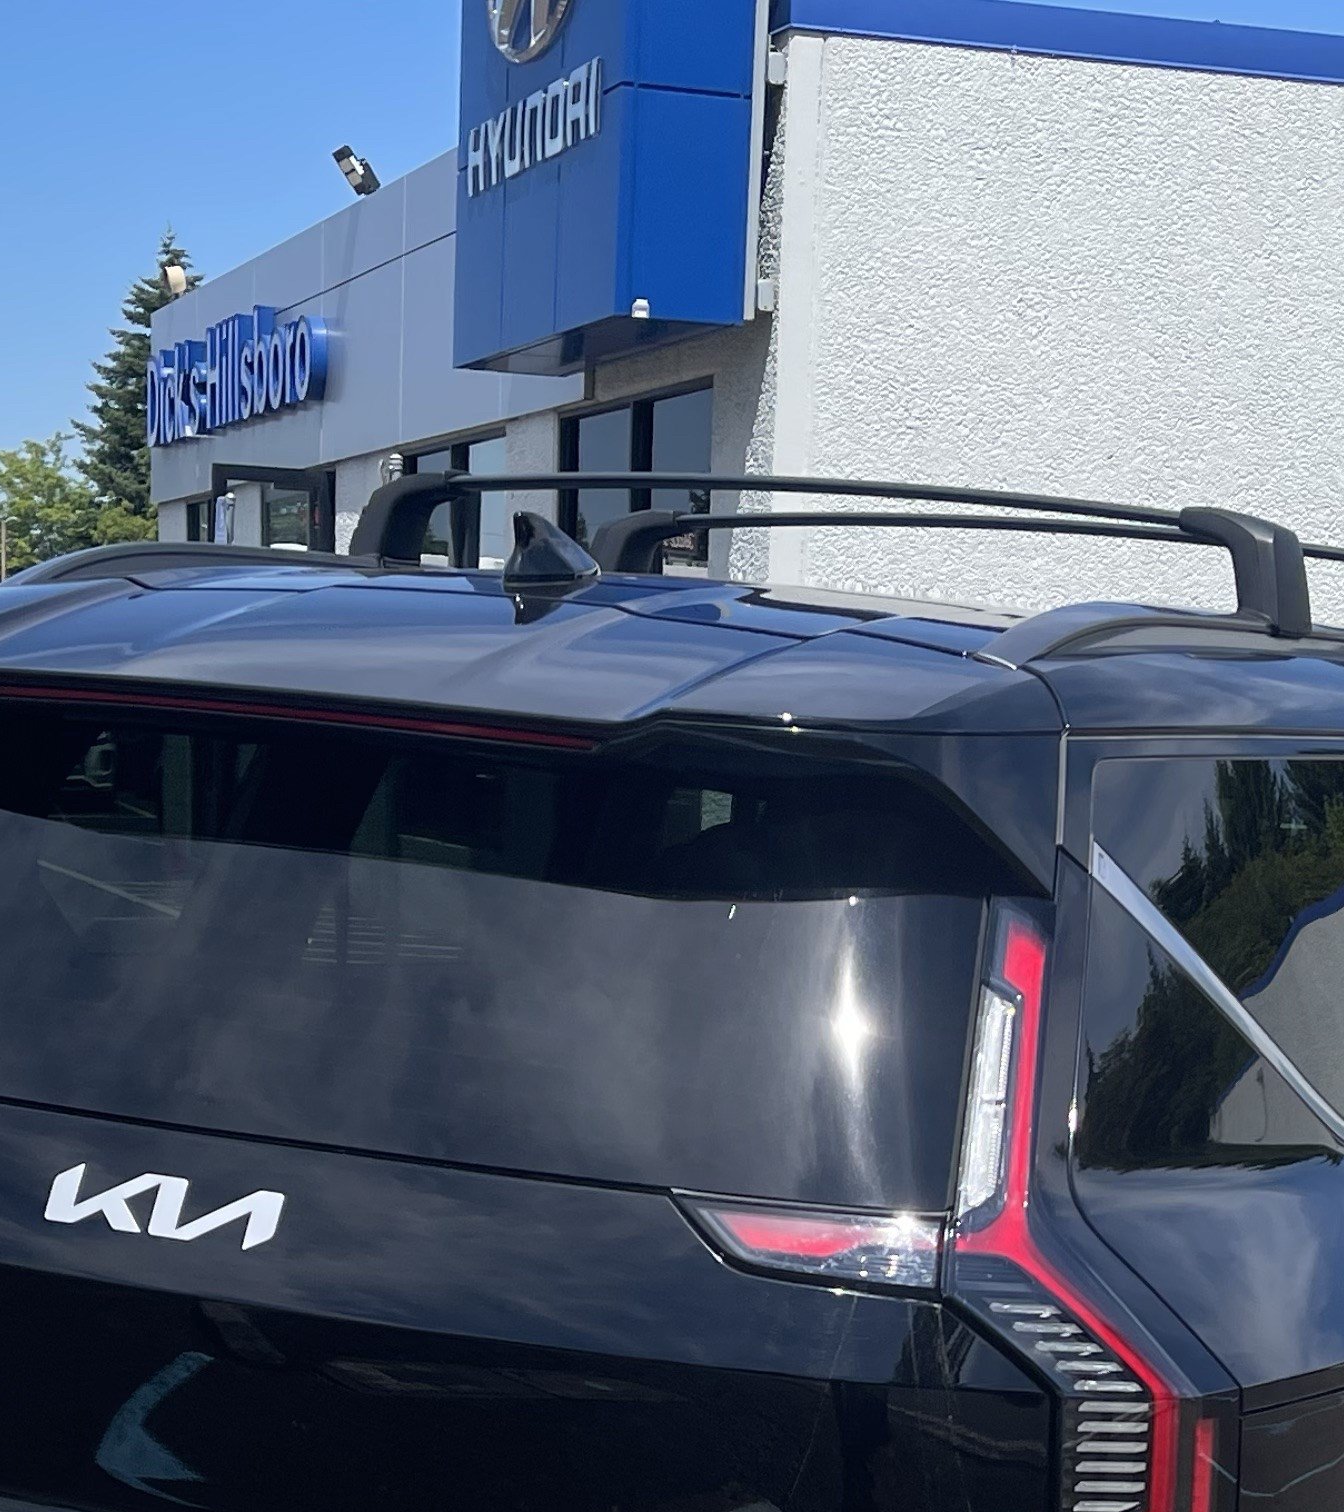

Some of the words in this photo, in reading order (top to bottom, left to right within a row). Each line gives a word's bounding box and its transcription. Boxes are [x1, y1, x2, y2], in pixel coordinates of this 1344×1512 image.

[467, 56, 602, 198] HYUNDAI
[206, 305, 312, 429] Hillsboro
[44, 1163, 285, 1250] KIA
